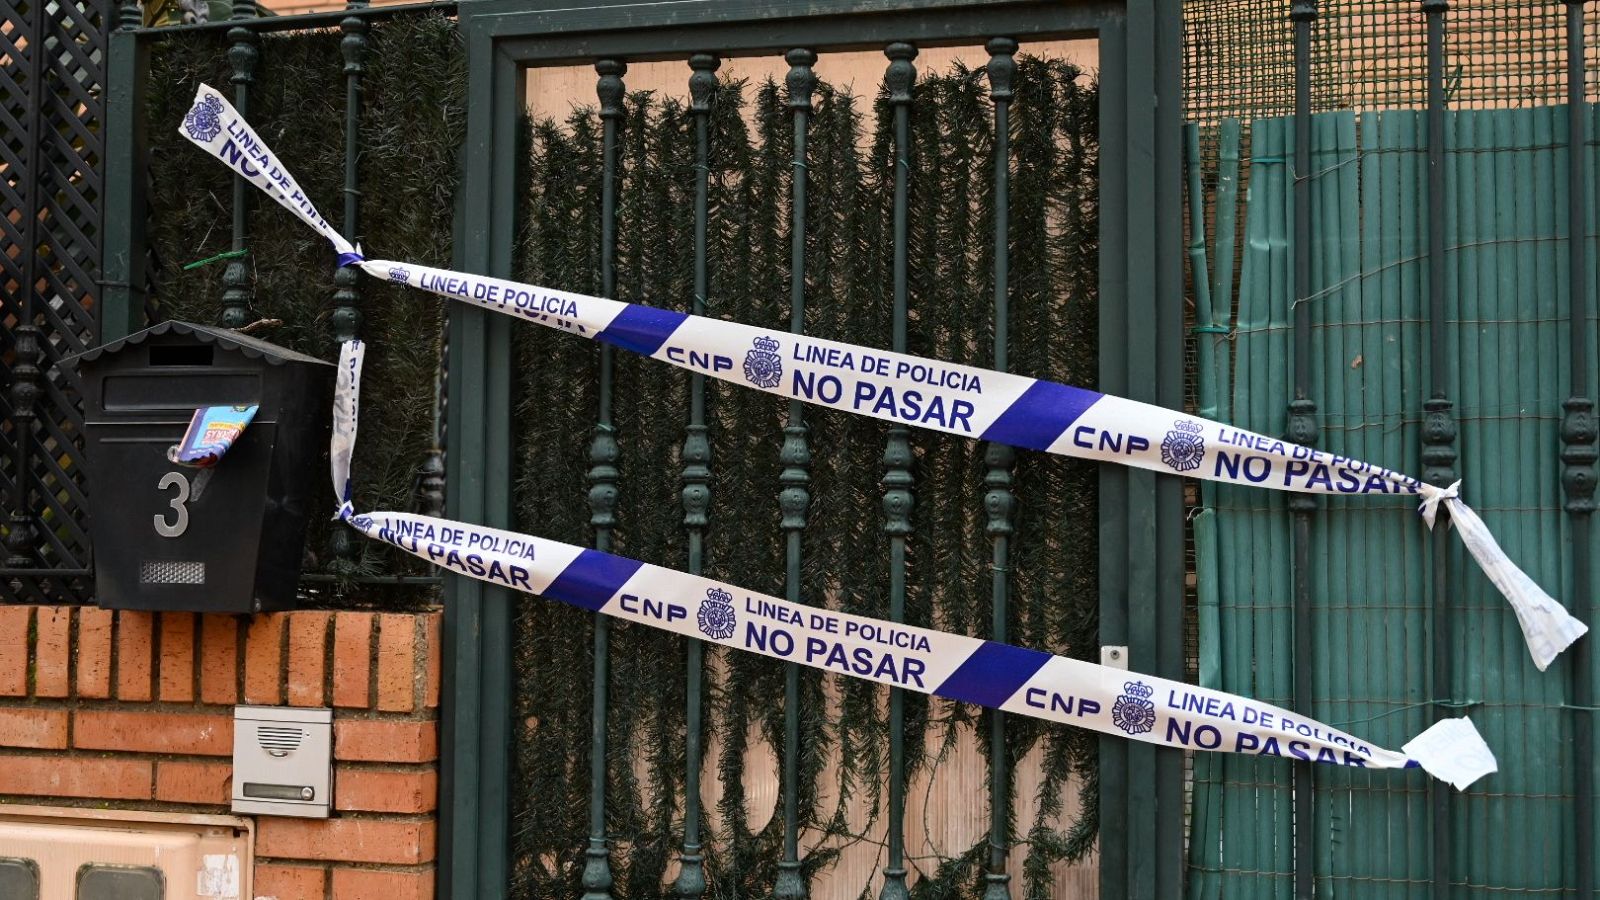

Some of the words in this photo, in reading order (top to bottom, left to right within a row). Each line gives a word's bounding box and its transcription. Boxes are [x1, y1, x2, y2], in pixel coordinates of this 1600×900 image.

[227, 119, 269, 169] LINEA
[269, 165, 291, 191] DE
[420, 273, 469, 297] LINEA
[474, 283, 499, 302] DE
[503, 288, 578, 318] POLICIA
[666, 346, 733, 372] CNP
[793, 343, 855, 371] LINEA
[861, 356, 890, 376] DE
[896, 362, 982, 394] POLICIA
[792, 369, 842, 403] NO
[854, 381, 975, 432] PASAR
[1073, 425, 1150, 455] CNP
[1218, 429, 1286, 456] LINEA
[1292, 446, 1323, 463] DE
[1214, 451, 1272, 482] NO
[153, 471, 190, 537] 3
[384, 518, 435, 541] LINEA
[440, 527, 463, 545] DE
[468, 533, 535, 560] POLICIA
[427, 542, 532, 590] PASAR
[619, 594, 688, 622] CNP
[745, 597, 804, 628] LINEA
[810, 615, 838, 634] DE
[845, 621, 931, 653] POLICIA
[745, 621, 795, 656] NO
[806, 638, 926, 688] PASAR
[1025, 687, 1101, 717] CNP
[1167, 690, 1236, 721] LINEA
[1242, 706, 1274, 728] DE
[1281, 718, 1372, 758] POLICIA
[1165, 717, 1222, 749] NO
